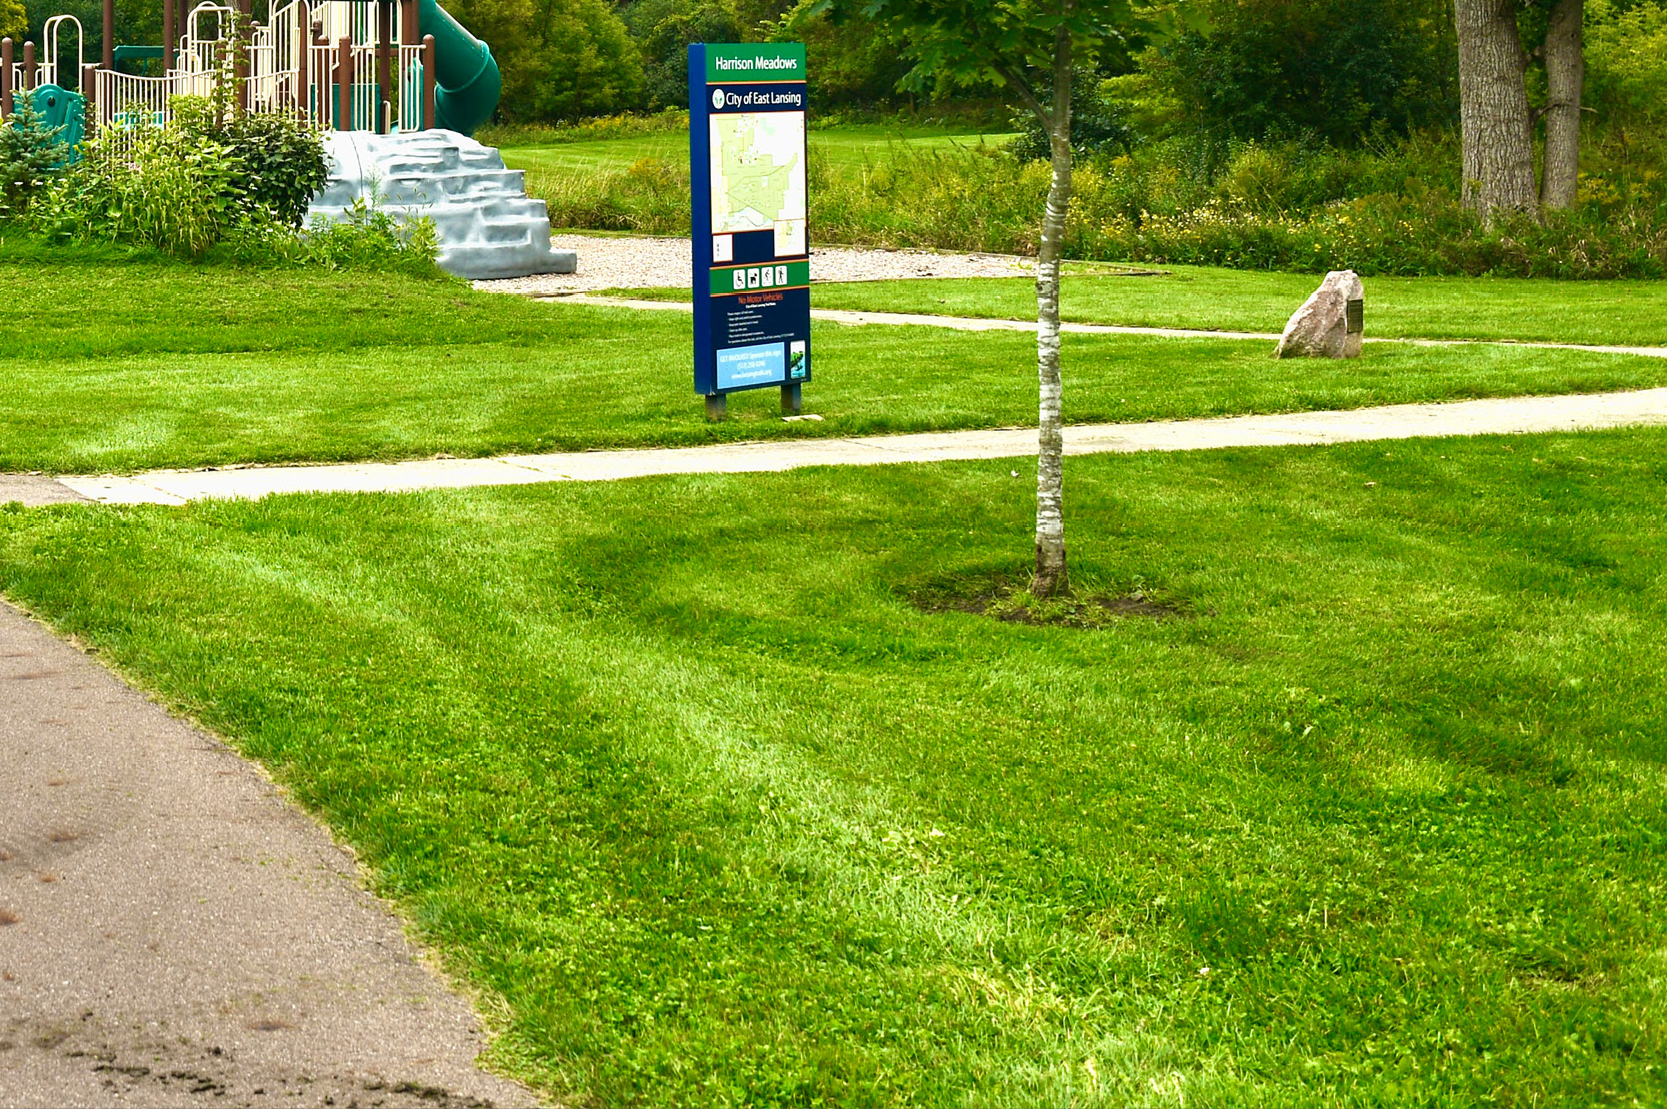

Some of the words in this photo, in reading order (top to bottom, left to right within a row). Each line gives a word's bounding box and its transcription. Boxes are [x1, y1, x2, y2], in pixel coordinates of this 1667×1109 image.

[715, 56, 754, 70] Harrison
[755, 55, 797, 70] Meadows
[726, 92, 742, 108] City
[743, 92, 752, 105] of
[754, 92, 770, 104] East
[771, 91, 802, 107] Lansing
[739, 296, 746, 304] No
[747, 295, 762, 303] Motor
[763, 293, 783, 302] Vehicles
